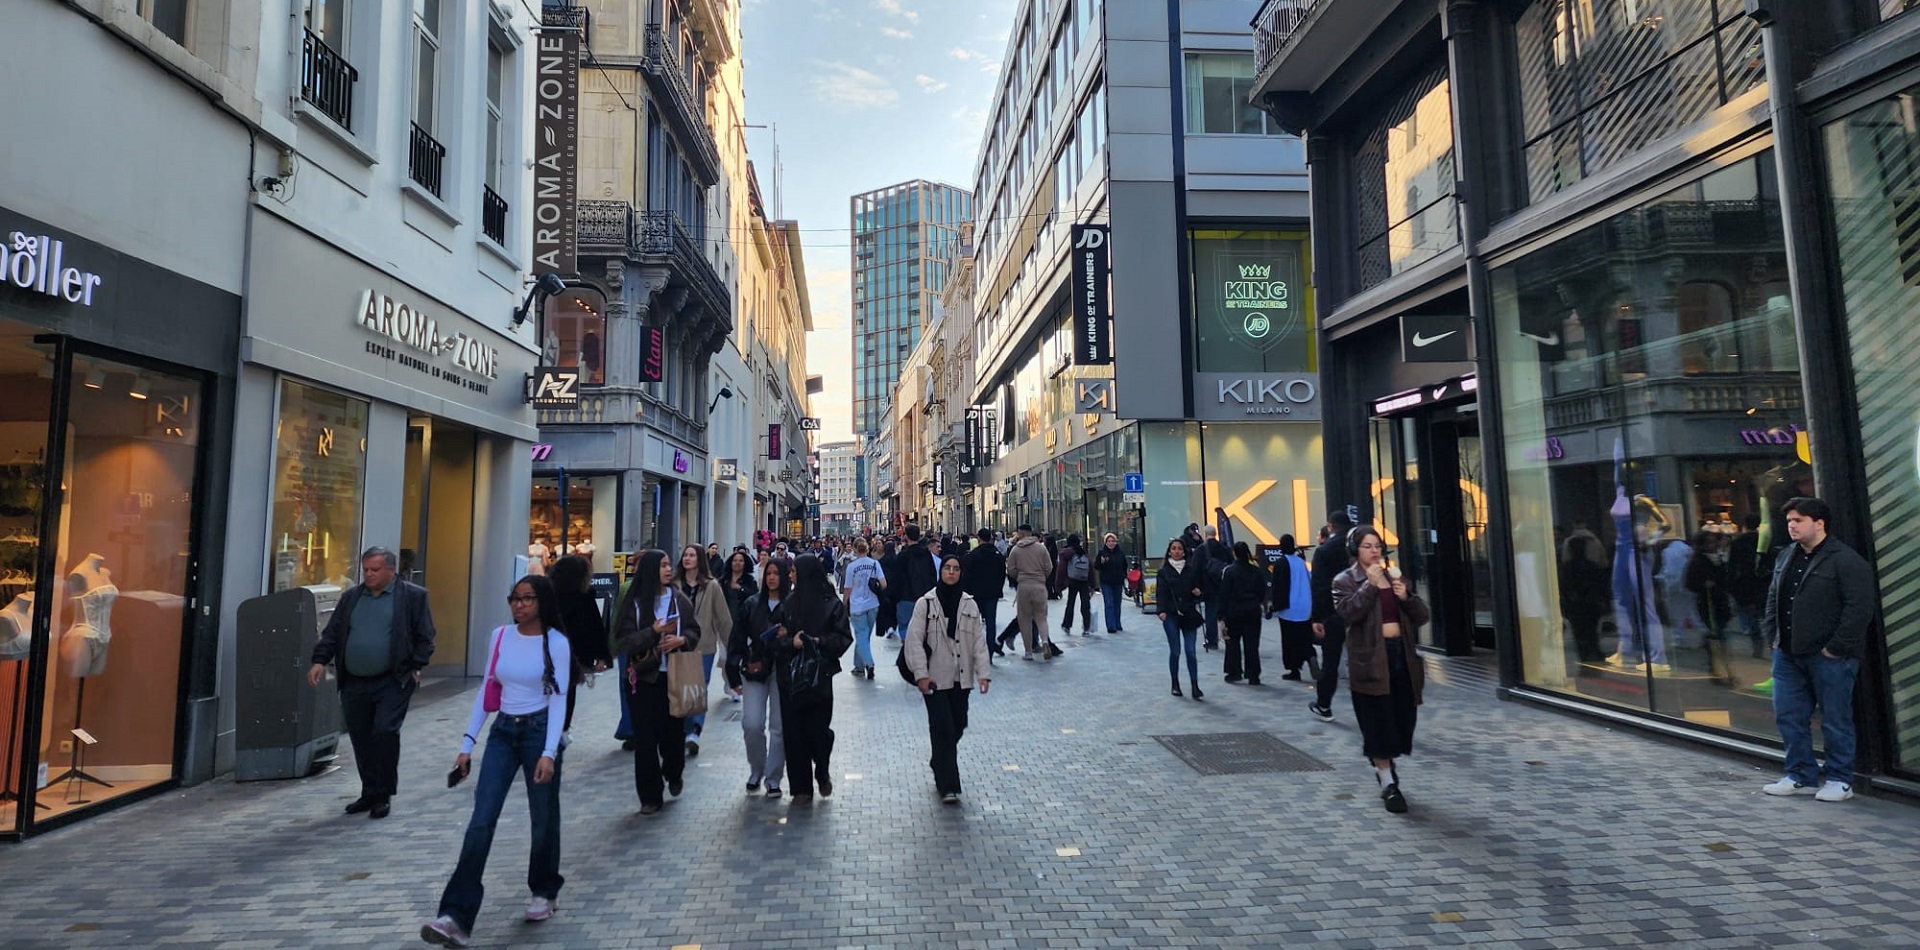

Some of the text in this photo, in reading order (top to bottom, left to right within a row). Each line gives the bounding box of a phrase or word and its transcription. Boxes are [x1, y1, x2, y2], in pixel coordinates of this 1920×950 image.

[567, 107, 575, 139] SOINS
[536, 37, 564, 269] AROMA ZONE
[567, 145, 574, 157] EN
[565, 216, 573, 257] EXPERT
[1075, 229, 1104, 249] JD
[1086, 252, 1096, 342] KING OF TRAINERS
[1225, 281, 1287, 300] KING
[1236, 300, 1287, 309] TRAINERS
[358, 288, 498, 380] AROMA ZONE
[1248, 317, 1267, 331] JD
[645, 328, 661, 379] Etam
[1218, 379, 1315, 403] KIKO
